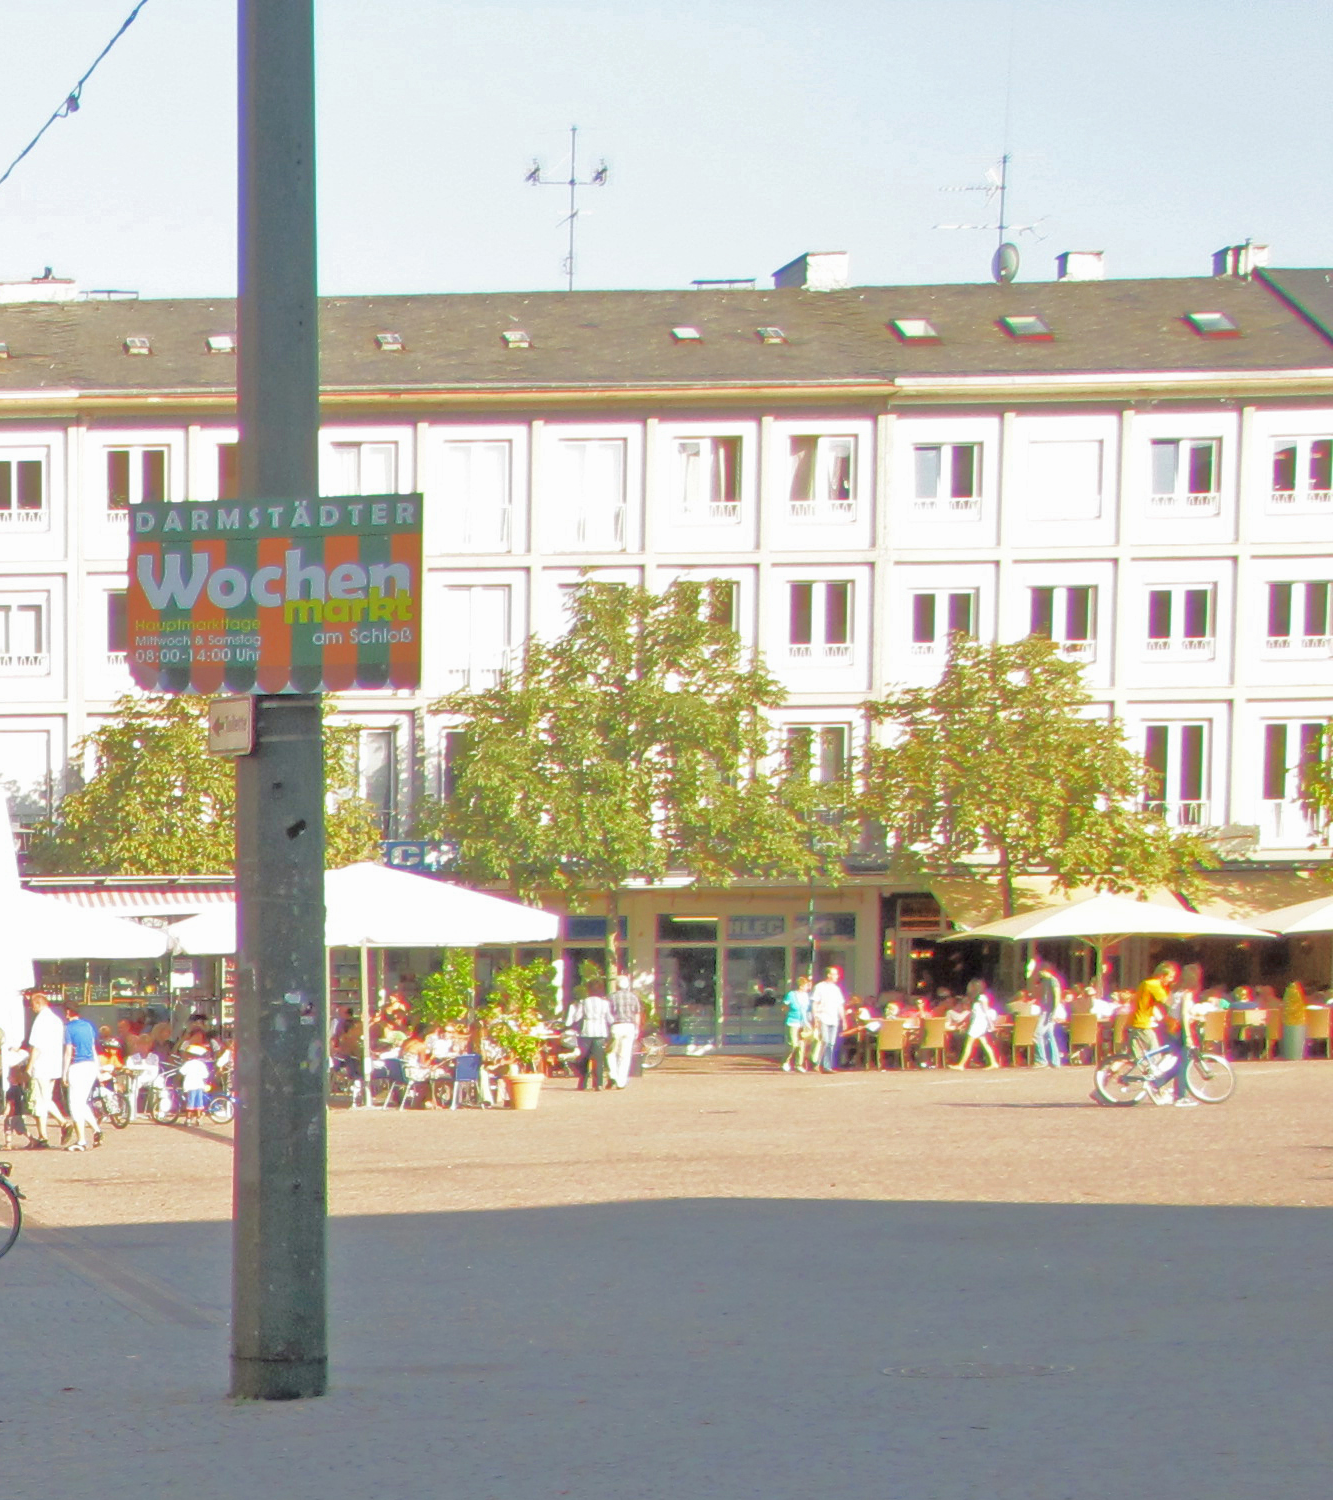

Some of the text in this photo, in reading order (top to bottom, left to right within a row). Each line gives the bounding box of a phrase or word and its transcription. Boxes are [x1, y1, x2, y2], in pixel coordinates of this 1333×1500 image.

[135, 501, 415, 533] DARMSTÄDTER
[137, 549, 411, 609] Wochen
[285, 586, 413, 624] markt
[135, 618, 261, 633] Hauptmarkttage
[135, 634, 261, 647] Mittwoch & Samstag
[312, 627, 413, 646] am Schloß
[135, 648, 261, 663] 08:00-14:00 Uhr
